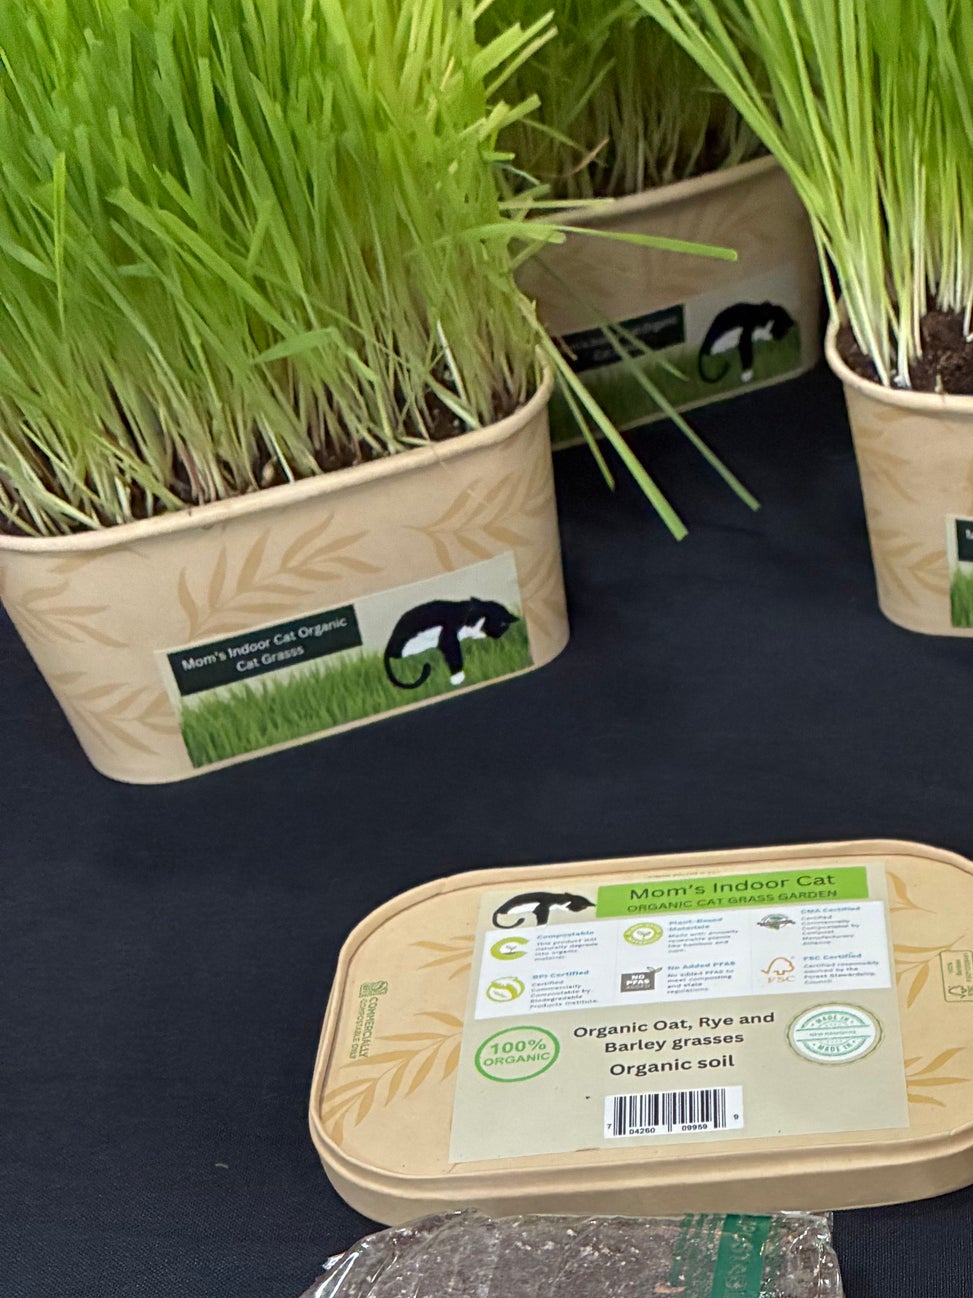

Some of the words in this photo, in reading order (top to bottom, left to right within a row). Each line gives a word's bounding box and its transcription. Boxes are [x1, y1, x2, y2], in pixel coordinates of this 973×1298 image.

[181, 651, 227, 672] Mom's
[228, 637, 271, 659] Indoor
[273, 630, 297, 646] Cat
[298, 616, 348, 640] Organic
[236, 659, 260, 673] Cat
[630, 884, 705, 900] Mom's
[713, 877, 790, 894] Indoor
[796, 874, 836, 887] Cat
[626, 900, 690, 913] ORGANIC
[696, 897, 723, 908] CAT
[727, 893, 775, 906] GRASS
[778, 889, 838, 902] GARDEN
[358, 996, 379, 1058] COMMERCIALLY
[573, 1021, 648, 1041] Organic
[653, 1018, 693, 1033] Oat,
[698, 1015, 734, 1031] Rye
[739, 1011, 775, 1025] and
[490, 1038, 547, 1055] 100%
[604, 1038, 667, 1054] Barley
[672, 1033, 745, 1051] grasses
[483, 1051, 551, 1067] ORGANIC
[609, 1059, 693, 1078] Organic
[697, 1054, 735, 1069] soil
[628, 1127, 656, 1135] 04260
[681, 1123, 708, 1131] 09959
